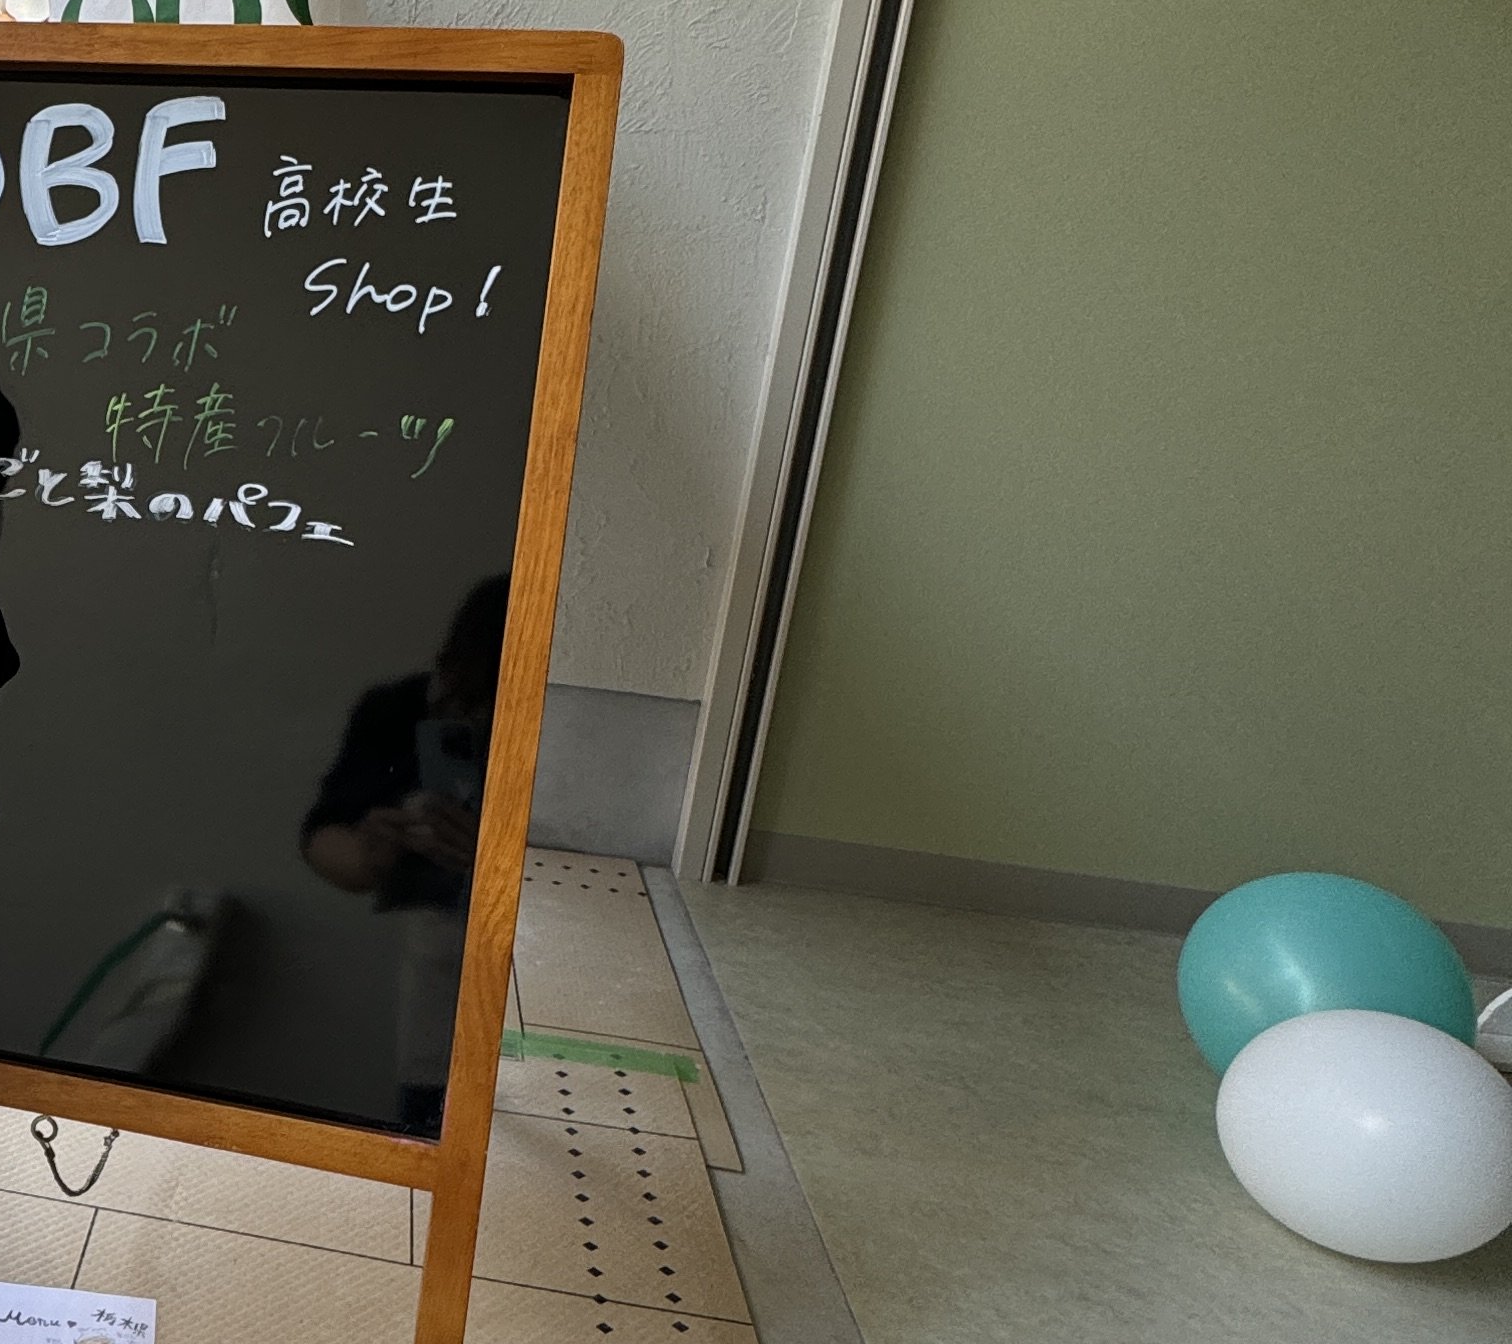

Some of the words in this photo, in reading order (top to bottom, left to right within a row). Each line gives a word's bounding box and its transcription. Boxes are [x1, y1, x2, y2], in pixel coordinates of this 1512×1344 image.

[263, 155, 458, 238] 高校生
[91, 1308, 149, 1339] 栃木県
